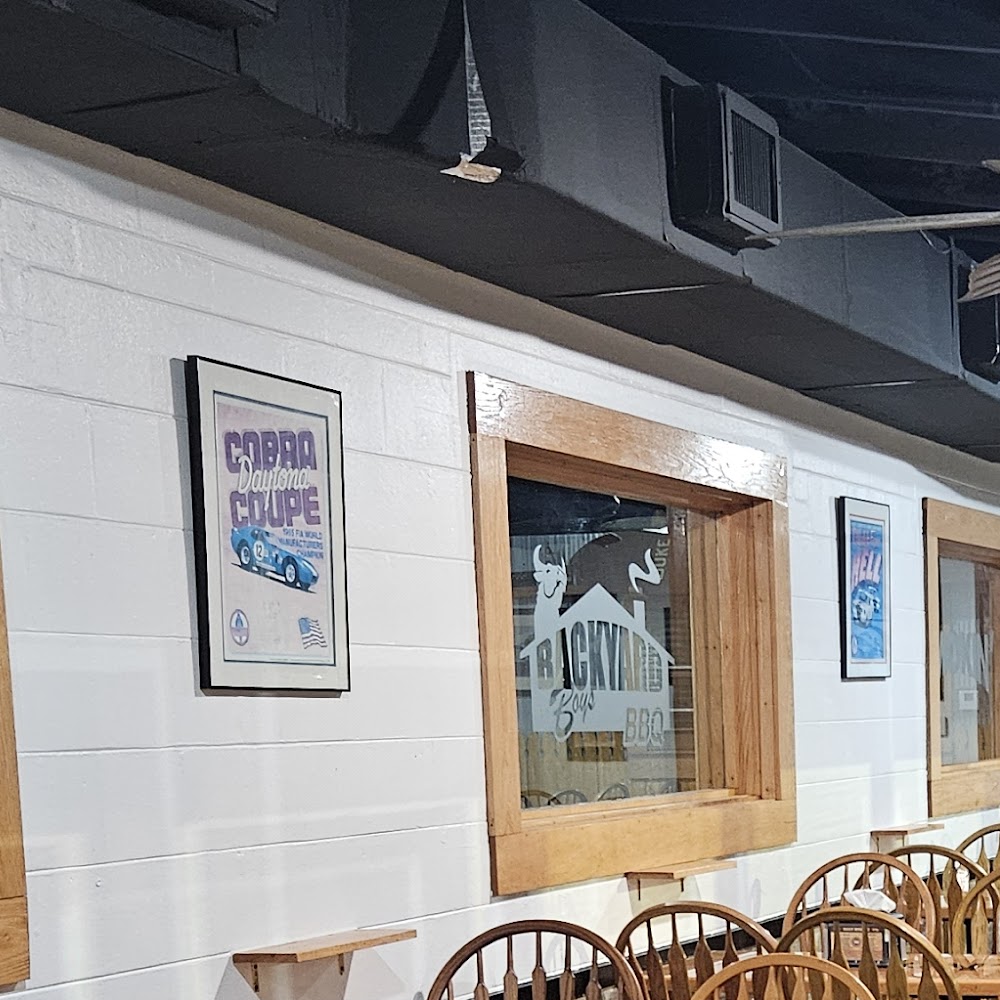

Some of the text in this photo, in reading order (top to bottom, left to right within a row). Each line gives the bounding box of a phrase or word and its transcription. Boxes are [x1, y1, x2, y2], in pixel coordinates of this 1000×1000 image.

[224, 430, 317, 474] COBRA
[238, 453, 310, 512] Daytona
[230, 486, 321, 528] COUPE
[625, 707, 665, 743] BBQ
